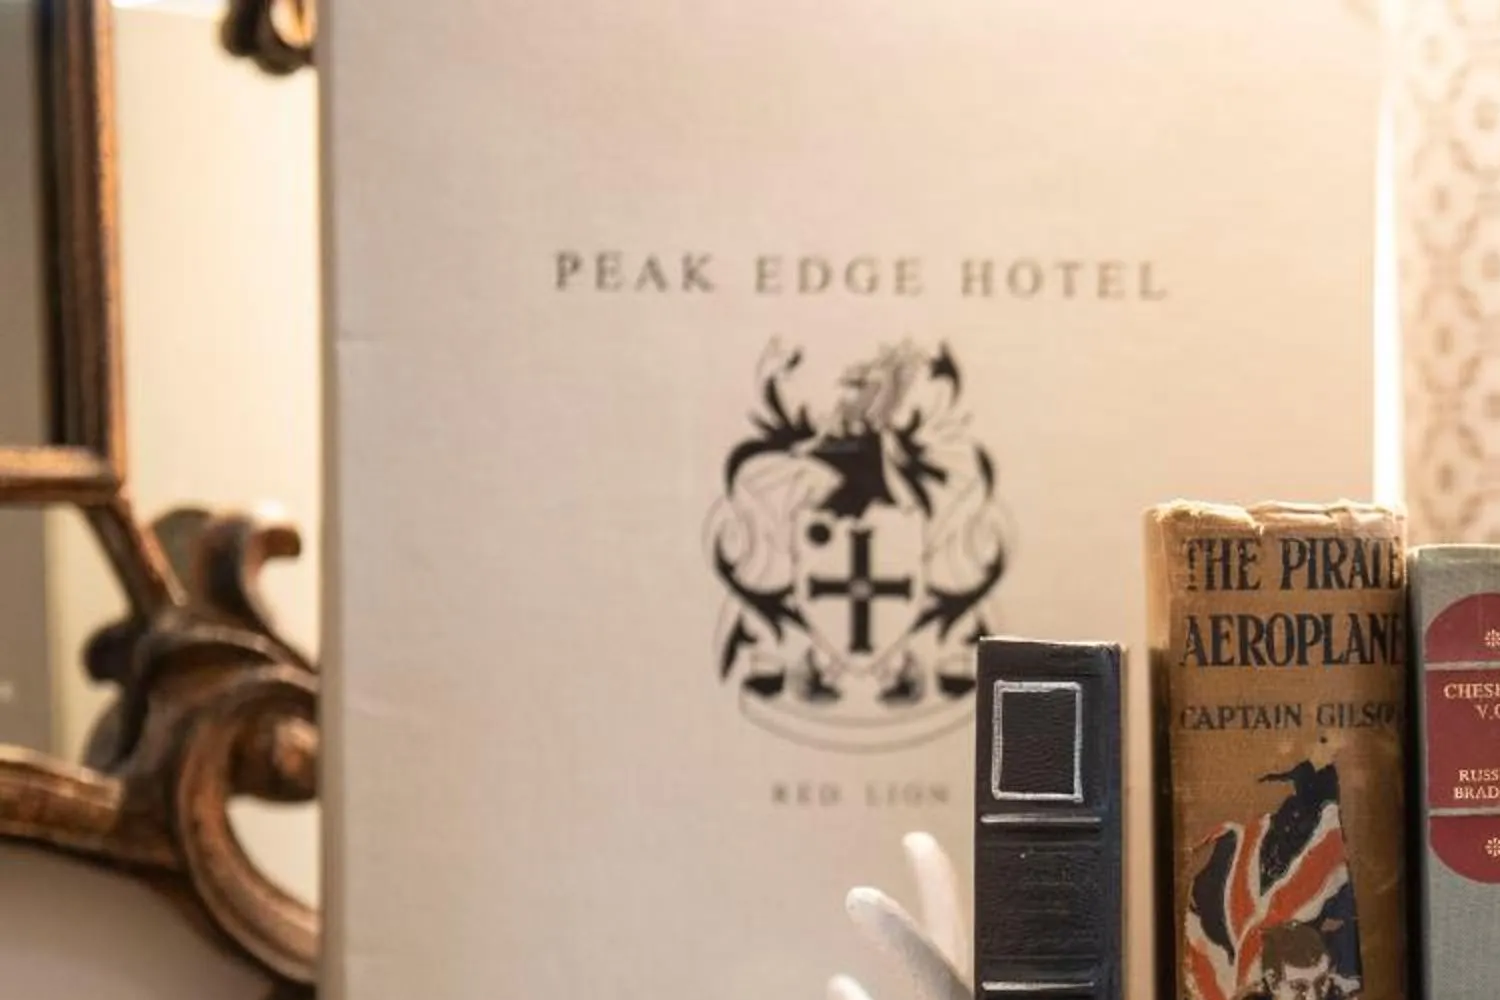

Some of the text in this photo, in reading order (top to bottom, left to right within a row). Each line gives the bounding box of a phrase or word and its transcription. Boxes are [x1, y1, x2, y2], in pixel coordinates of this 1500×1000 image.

[555, 250, 1168, 301] PEAK EDGE HOTEL
[1185, 537, 1262, 591] THE
[1179, 701, 1403, 731] CAPTAIN GILSO
